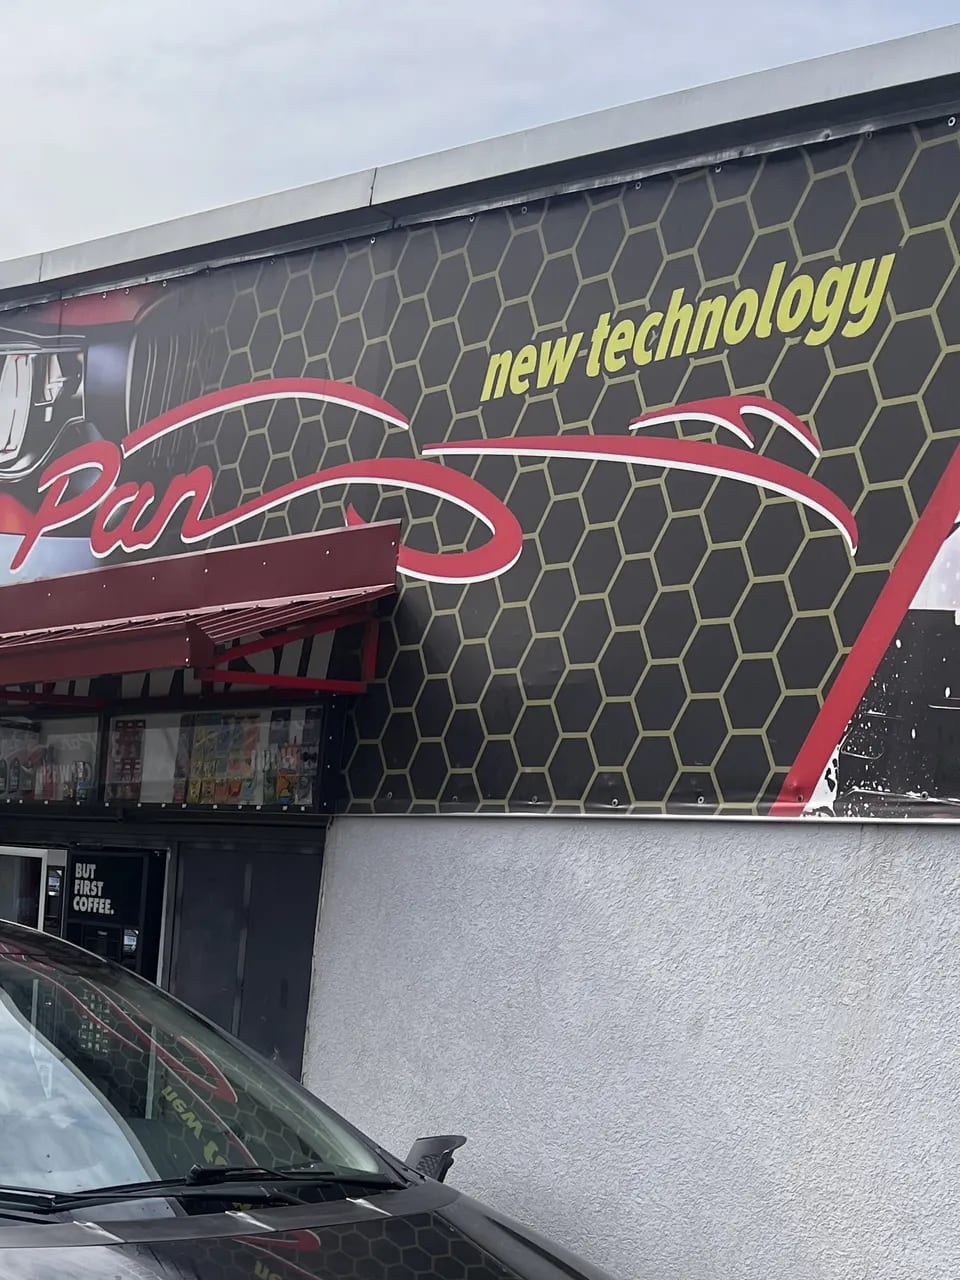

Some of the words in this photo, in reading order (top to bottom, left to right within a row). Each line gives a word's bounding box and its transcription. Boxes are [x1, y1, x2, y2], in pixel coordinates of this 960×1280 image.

[480, 332, 585, 402] new
[585, 253, 897, 379] technology
[75, 862, 97, 879] BUT
[74, 879, 105, 897] FIRST
[72, 896, 115, 915] COFFEE.
